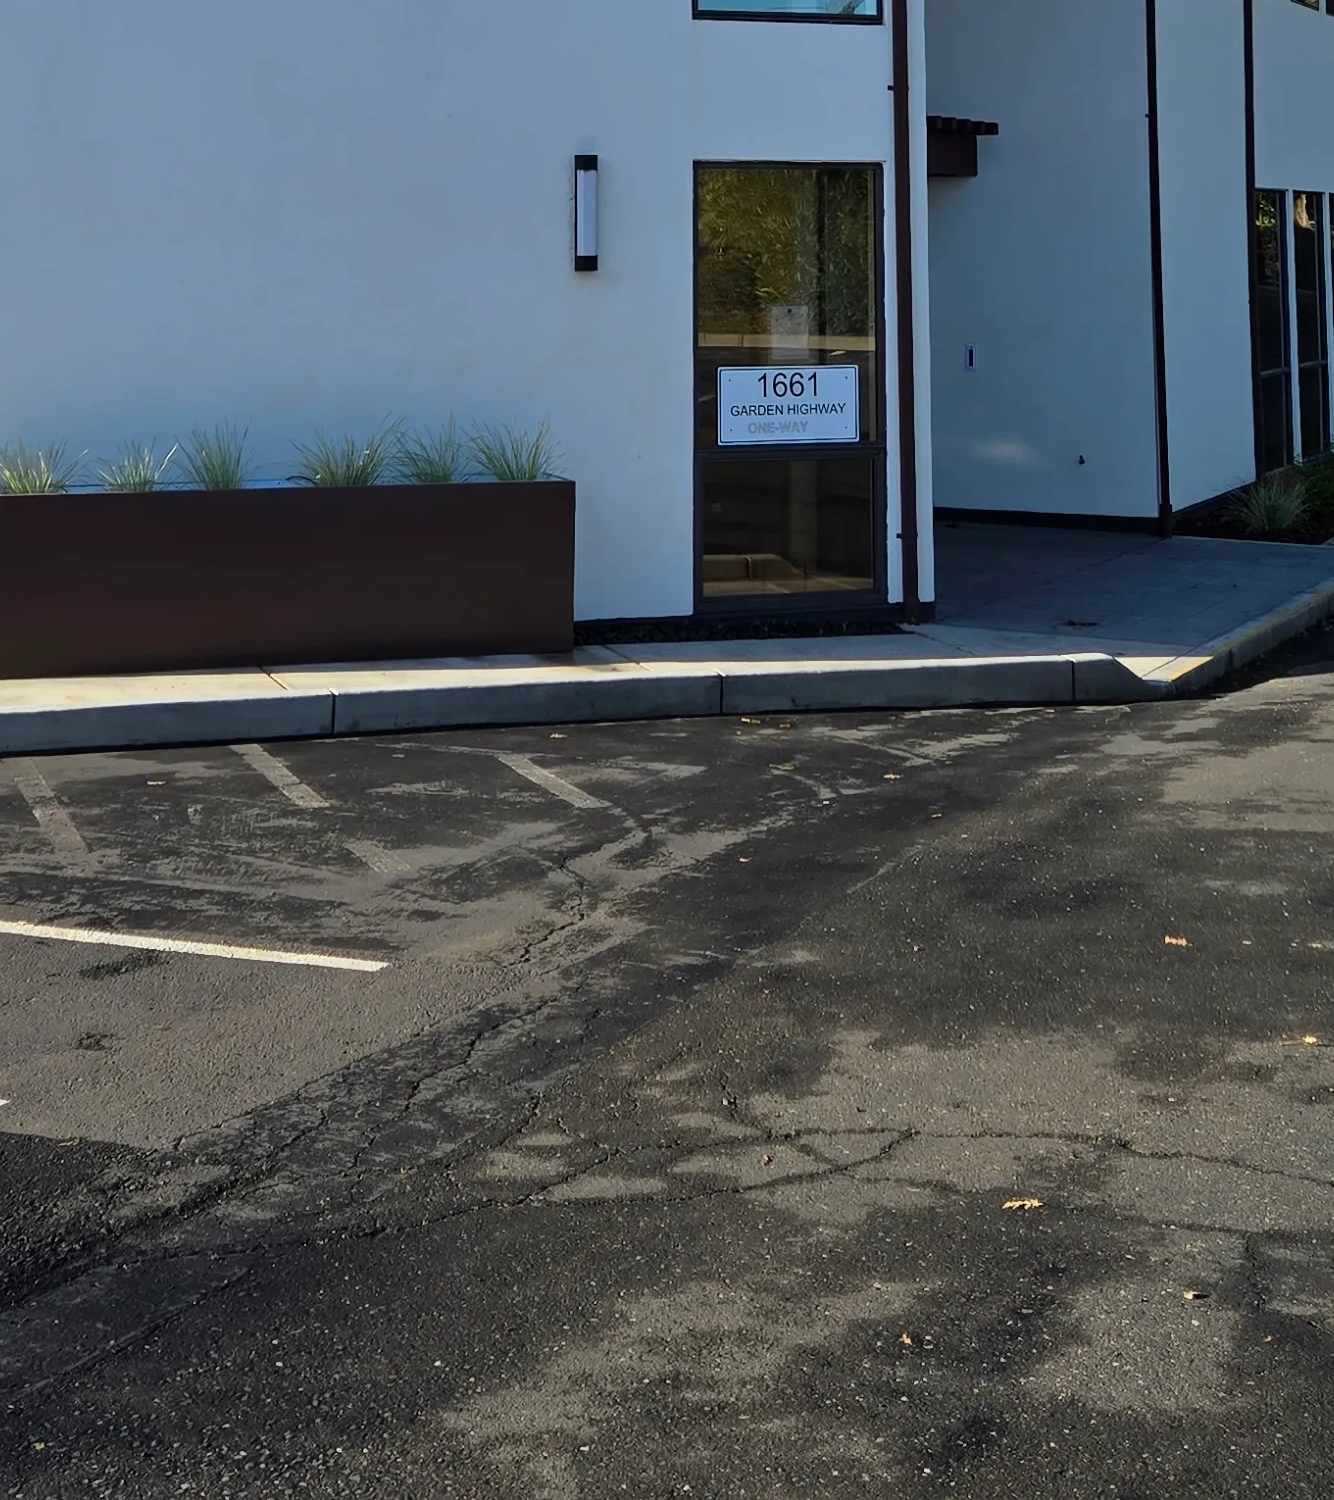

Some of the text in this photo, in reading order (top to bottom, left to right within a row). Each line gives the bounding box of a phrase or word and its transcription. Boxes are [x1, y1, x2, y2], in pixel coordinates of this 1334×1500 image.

[757, 371, 817, 398] 1661
[730, 402, 847, 417] GARDEN HIGHWAY
[747, 421, 809, 434] ONE-WAY
